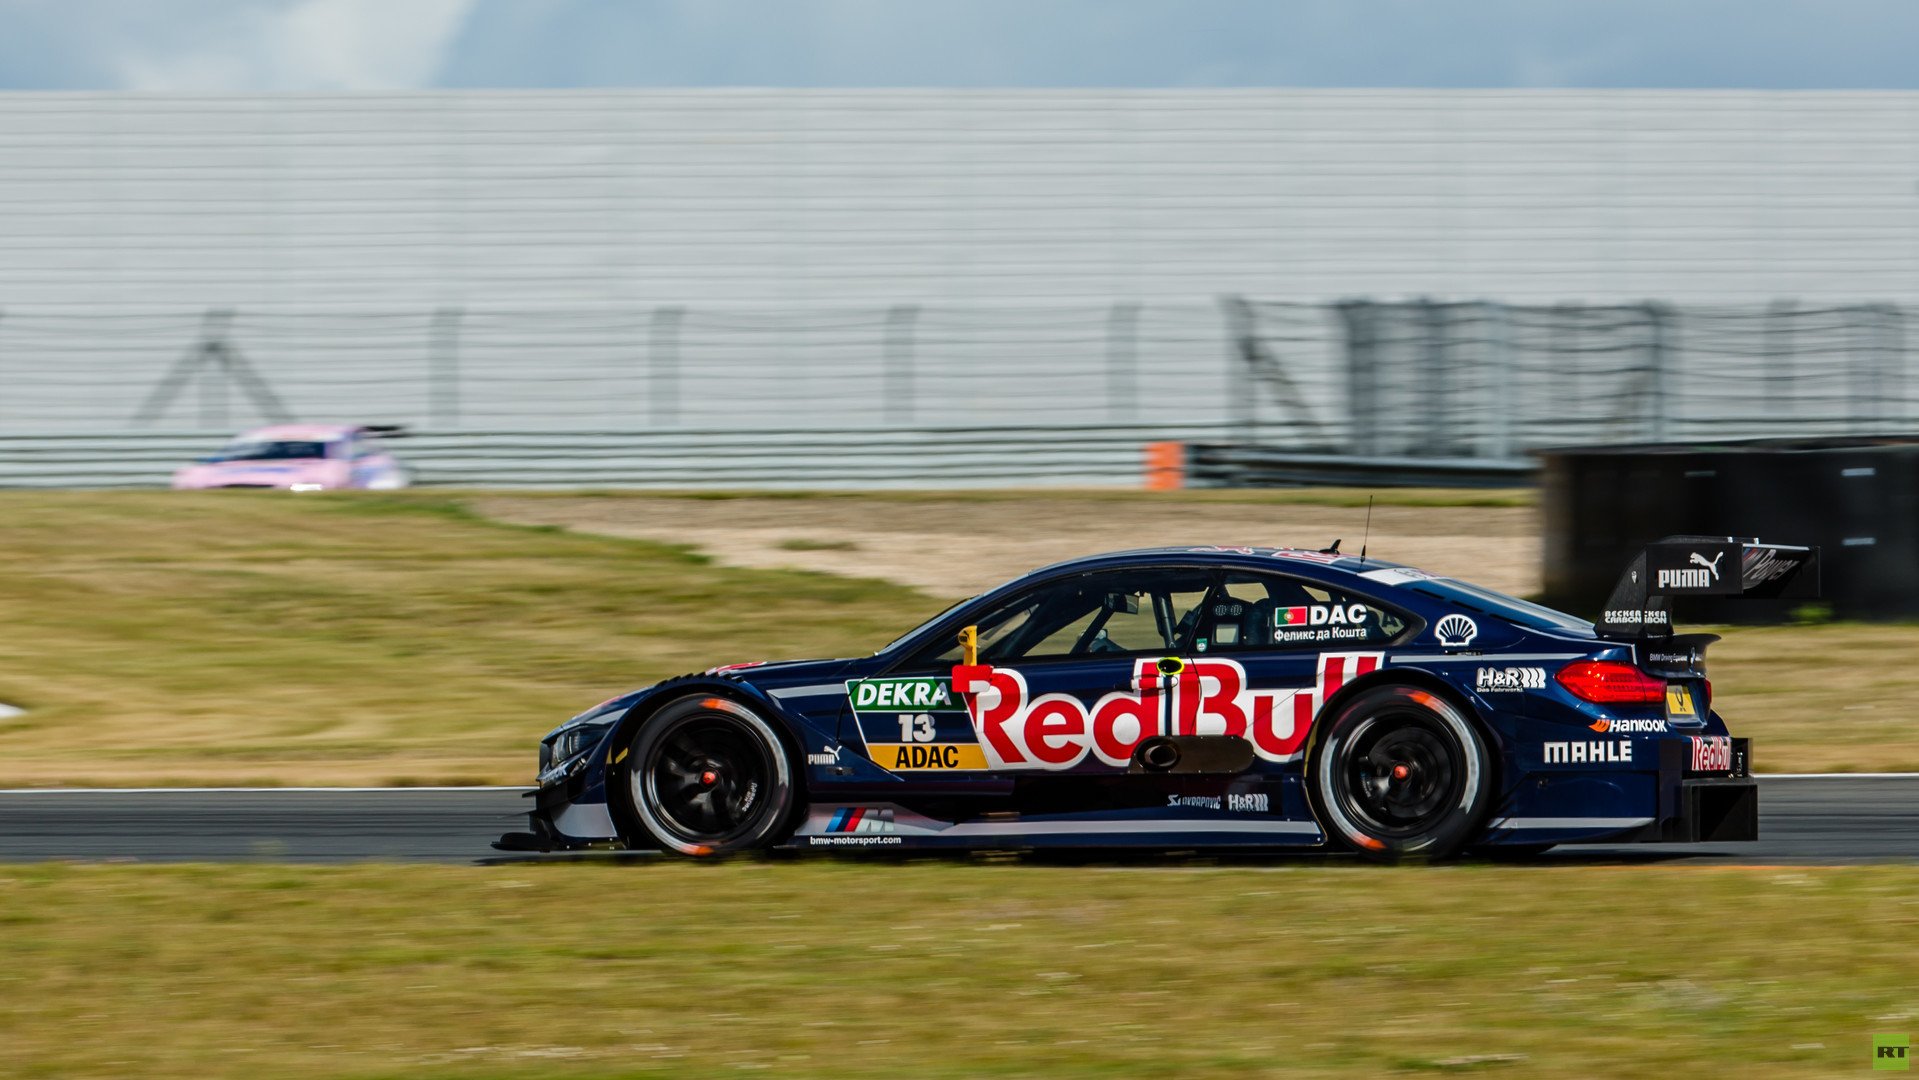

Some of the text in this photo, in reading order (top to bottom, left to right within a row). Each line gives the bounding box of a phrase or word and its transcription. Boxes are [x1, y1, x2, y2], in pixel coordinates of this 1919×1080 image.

[1658, 569, 1710, 588] PUMA
[1310, 603, 1367, 625] DAC
[1604, 610, 1641, 618] BECKER
[1274, 626, 1367, 641] Феликс да Кошта
[857, 682, 952, 706] DEKRA
[898, 713, 936, 742] 13
[808, 753, 835, 765] PUMA
[895, 745, 959, 768] ADAC
[1544, 741, 1632, 763] MAHLE
[810, 836, 902, 845] bmw-motorsport.com
